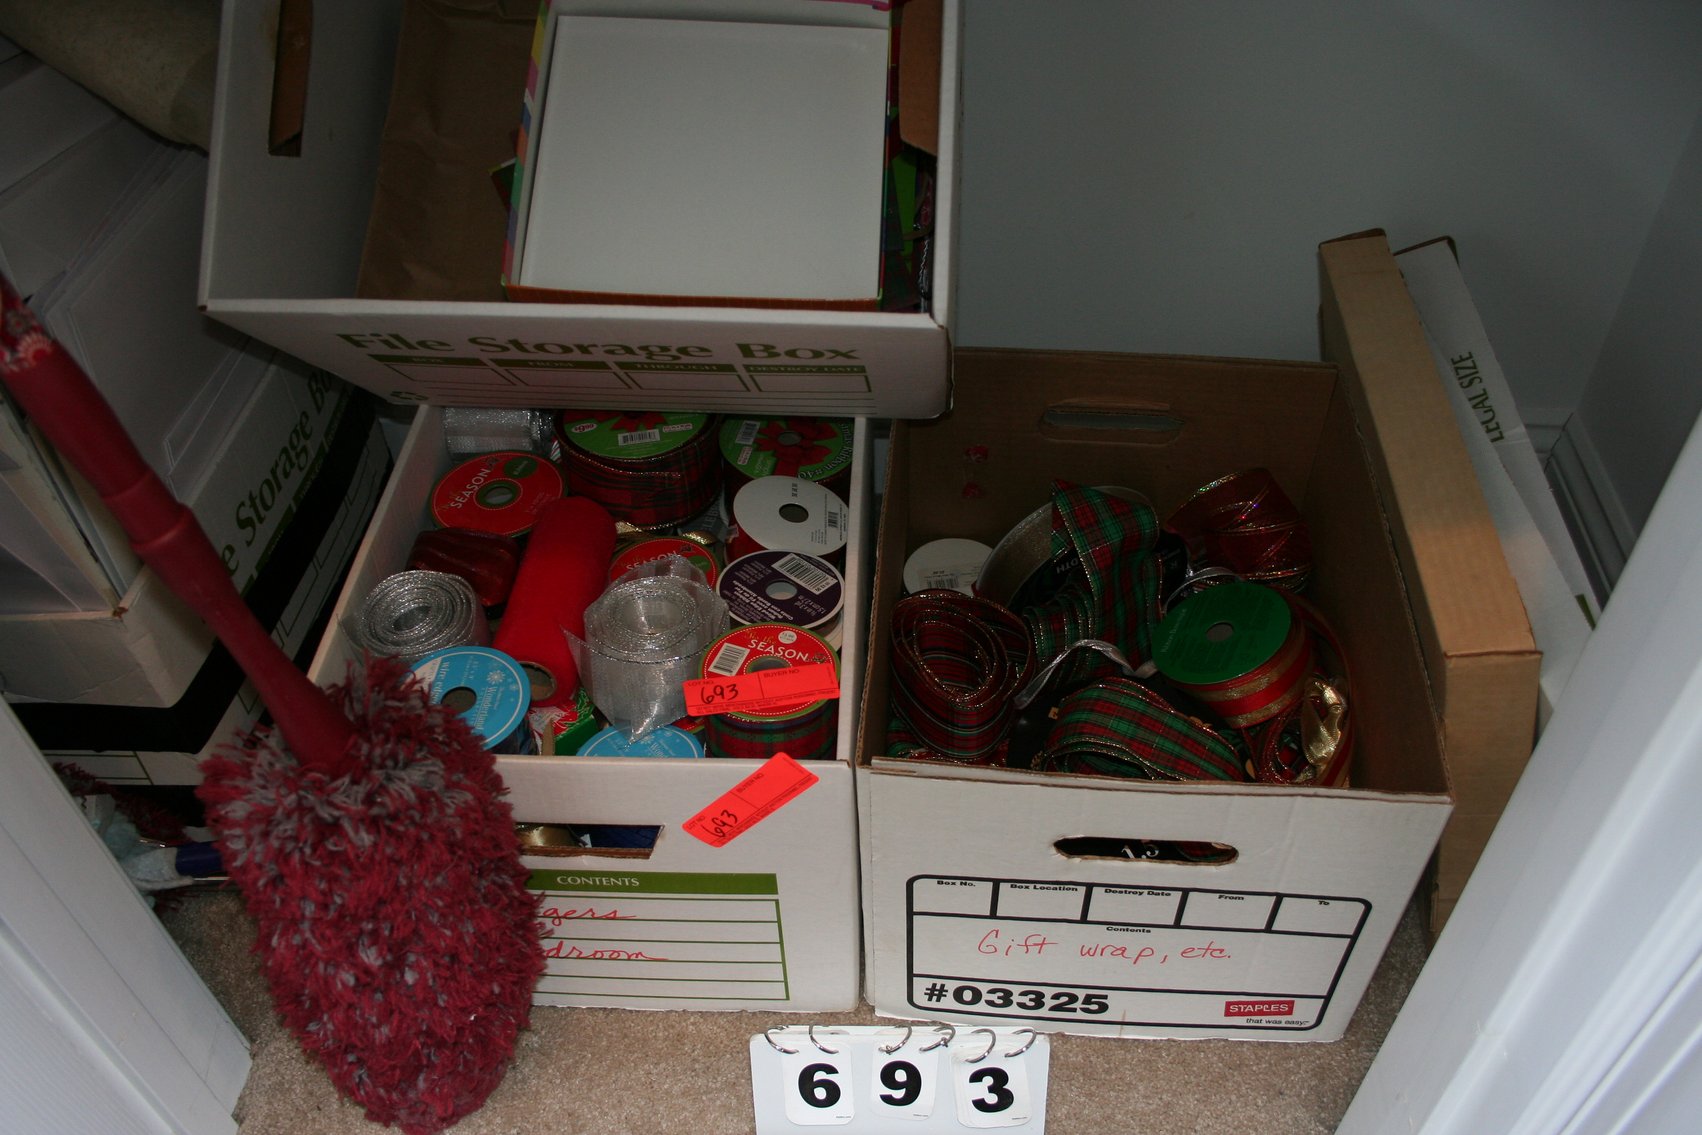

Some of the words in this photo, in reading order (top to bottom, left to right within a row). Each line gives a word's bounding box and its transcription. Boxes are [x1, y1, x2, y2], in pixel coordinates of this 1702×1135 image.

[336, 332, 455, 351] File
[467, 336, 713, 362] Storage
[735, 342, 861, 359] Box
[635, 363, 718, 371] THROUGH
[749, 365, 819, 373] DESTROY
[1450, 351, 1483, 390] SIZE
[1467, 387, 1505, 443] LEGAL
[234, 410, 313, 548] Storage
[449, 466, 493, 509] SEASON
[748, 639, 809, 661] SEASON
[700, 683, 739, 705] 693
[700, 809, 738, 838] 693
[556, 874, 641, 888] CONTENTS
[1010, 883, 1031, 891] Box
[1033, 884, 1079, 893] Location
[1104, 888, 1144, 897] Destroy
[542, 906, 637, 927] gers
[1105, 925, 1152, 934] Contents
[545, 940, 669, 961] droom
[977, 928, 1058, 956] Gift
[1080, 942, 1168, 964] wrap,
[1180, 941, 1232, 960] etc.
[924, 983, 1109, 1015] #03325
[1229, 1003, 1289, 1013] STAPLES
